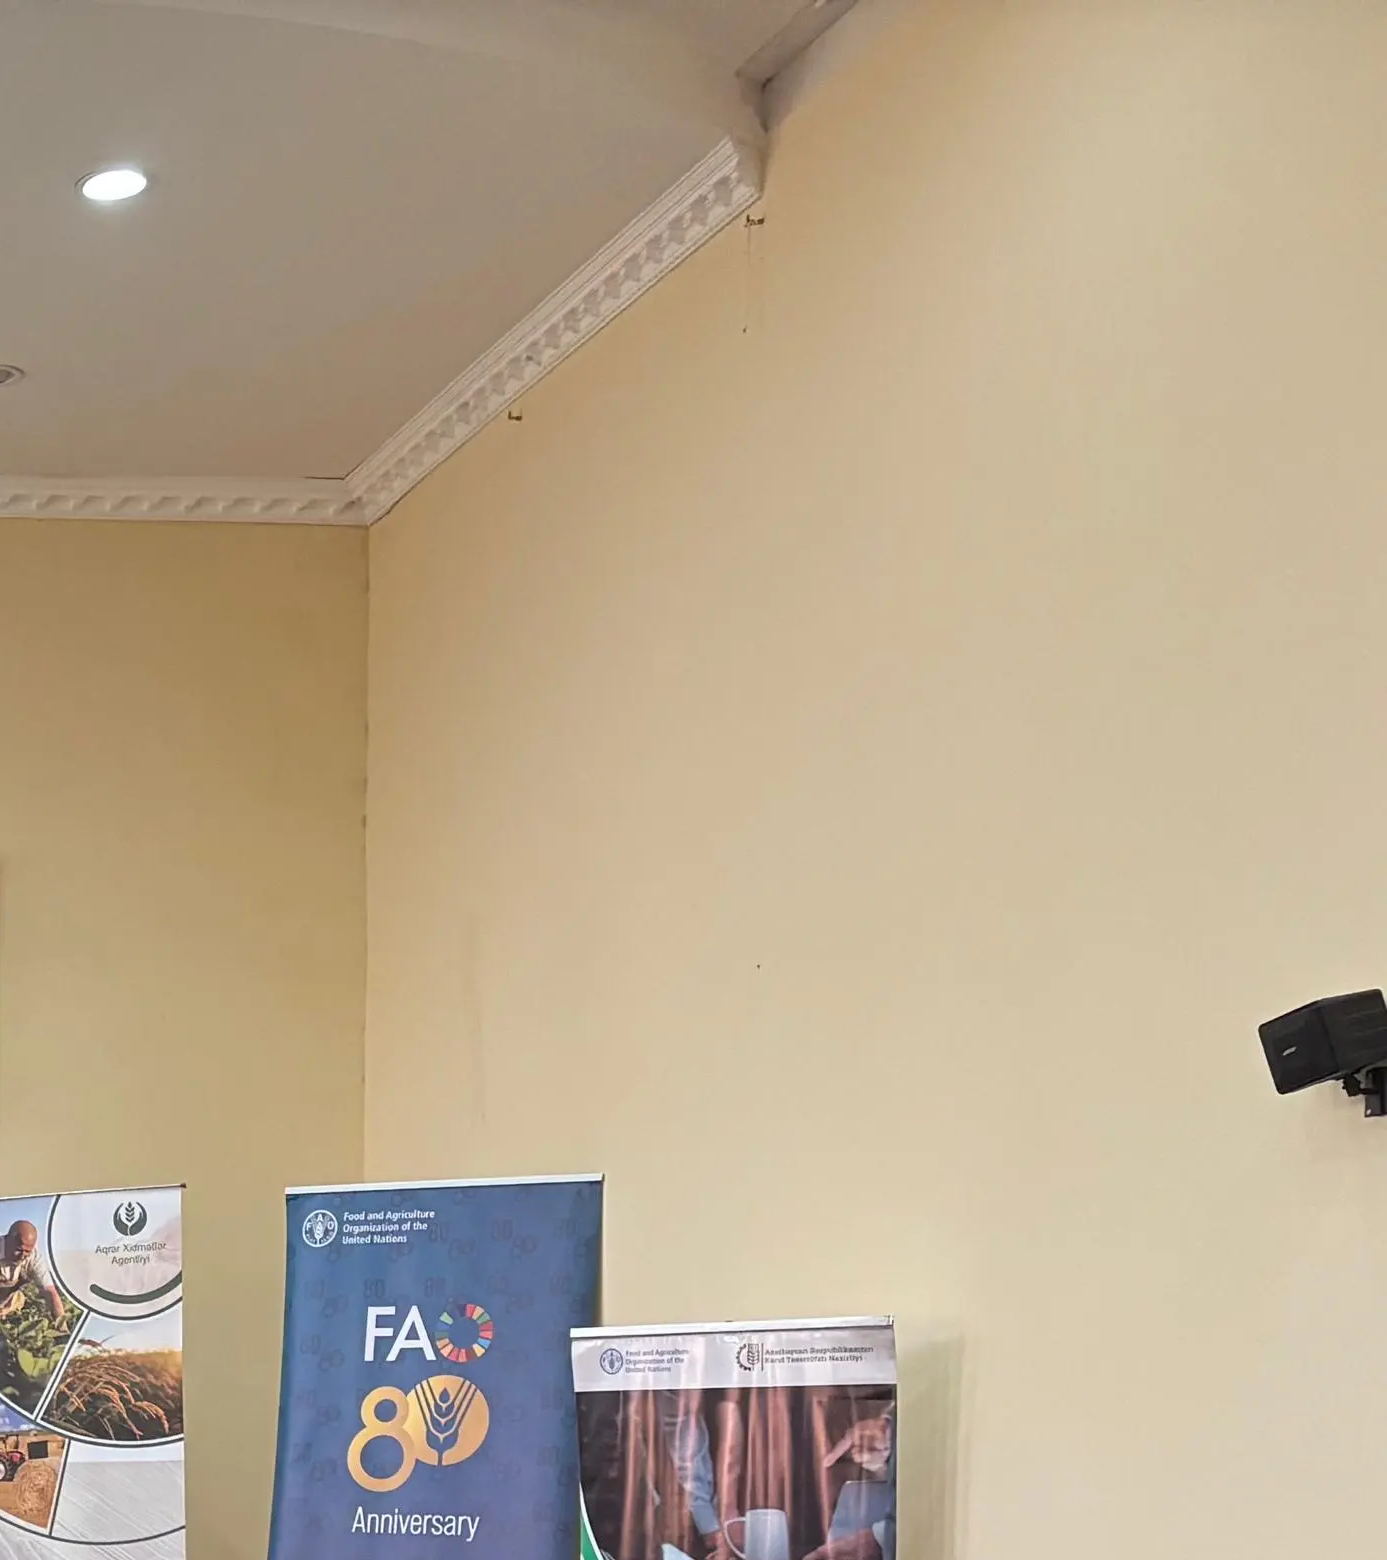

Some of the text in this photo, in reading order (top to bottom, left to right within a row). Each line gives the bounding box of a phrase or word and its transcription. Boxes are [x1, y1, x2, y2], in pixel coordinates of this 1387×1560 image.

[343, 1210, 435, 1222] Food and Agriculture
[343, 1222, 428, 1235] Organization of the
[342, 1235, 371, 1245] United
[373, 1235, 408, 1244] Nations
[364, 1303, 495, 1363] FAO
[351, 1506, 480, 1542] Anniversary
